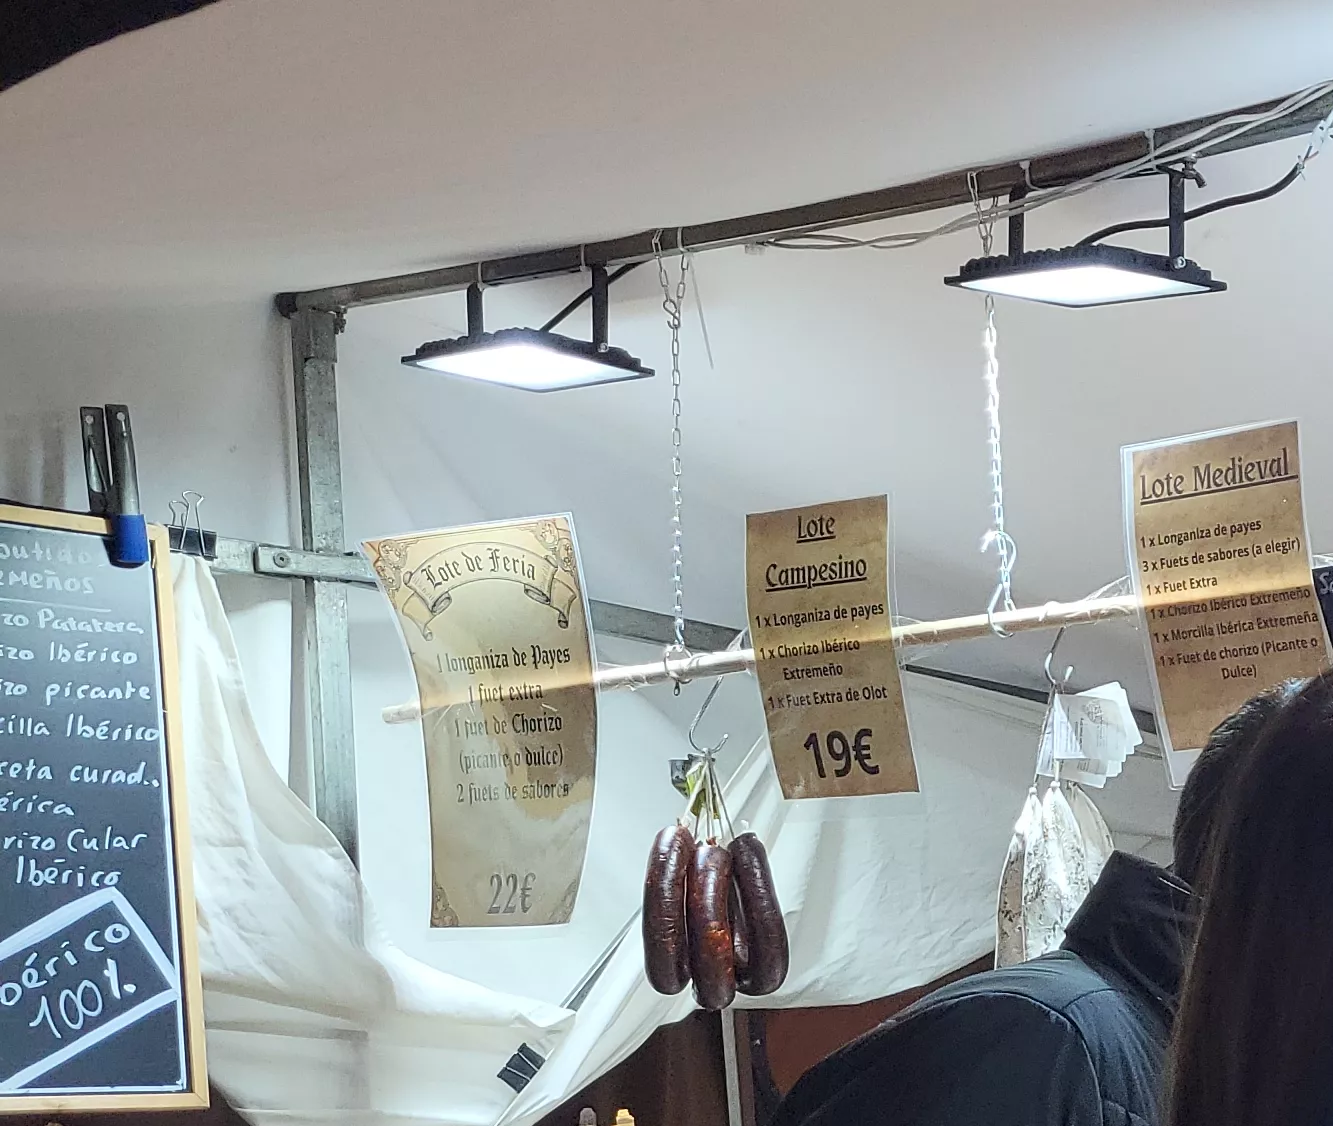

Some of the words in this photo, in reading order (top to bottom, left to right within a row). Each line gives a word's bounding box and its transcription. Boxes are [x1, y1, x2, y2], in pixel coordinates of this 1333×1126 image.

[1140, 472, 1185, 501] Lote
[1193, 447, 1289, 491] Medieval
[797, 515, 836, 541] Lote
[1140, 536, 1146, 548] 1
[1149, 538, 1155, 547] x
[1157, 527, 1211, 546] Longaniza
[1214, 523, 1227, 537] de
[1230, 520, 1262, 538] payes
[1142, 560, 1149, 572] 3
[1151, 561, 1158, 571] x
[1160, 556, 1189, 569] Fuets
[1191, 551, 1205, 564] de
[1207, 545, 1250, 562] sabores
[1251, 543, 1263, 558] (a
[1265, 536, 1301, 555] elegir)
[421, 560, 462, 589] Lote
[461, 552, 484, 573] de
[487, 548, 535, 581] Feria
[765, 555, 867, 590] Campesino
[1146, 583, 1152, 596] 1
[1154, 584, 1162, 594] x
[1163, 580, 1187, 593] Fuet
[1190, 575, 1218, 589] Extra
[755, 615, 762, 629] 1
[764, 617, 772, 627] x
[773, 610, 831, 629] Longaniza
[833, 605, 848, 620] de
[851, 602, 884, 621] payes
[1150, 607, 1156, 619] 1
[1159, 608, 1165, 618] x
[1167, 602, 1208, 618] Chorizo
[1210, 597, 1247, 612] Ibérico
[1250, 587, 1311, 606] Extremeño
[1153, 632, 1160, 644] 1
[1162, 632, 1169, 642] x
[1171, 624, 1215, 642] Morcilla
[1217, 620, 1254, 638] Ibérica
[1256, 611, 1319, 630] Extremeña
[50, 641, 138, 665] Ibérico
[446, 650, 509, 675] longaniza
[512, 646, 527, 667] de
[531, 645, 571, 670] Payes
[760, 647, 766, 661] 1
[768, 650, 775, 660] x
[777, 642, 819, 658] Chorizo
[821, 638, 860, 653] Ibérico
[1159, 655, 1165, 667] 1
[1168, 656, 1175, 666] x
[1177, 652, 1201, 666] Fuet
[1203, 648, 1217, 662] de
[1219, 643, 1259, 661] chorizo
[1261, 639, 1308, 656] (Picante
[1310, 637, 1318, 647] o
[783, 663, 843, 681] Extremeño
[1221, 664, 1257, 680] Dulce)
[45, 681, 151, 705] picante
[468, 687, 474, 704] 1
[477, 684, 505, 706] fuet
[509, 684, 543, 700] extra
[768, 696, 775, 709] 1
[778, 698, 785, 708] x
[786, 692, 811, 707] Fuet
[813, 688, 843, 706] Extra
[845, 686, 860, 701] de
[862, 686, 888, 700] Olot
[455, 720, 460, 737] 1
[464, 719, 488, 739] fuet
[493, 716, 507, 735] de
[512, 712, 562, 735] Chorizo
[459, 749, 509, 774] (picante
[514, 754, 520, 766] o
[525, 744, 564, 766] dulce)
[804, 728, 880, 778] 19€
[456, 784, 465, 803] 2
[468, 782, 499, 806] fuets
[504, 781, 518, 799] de
[522, 779, 570, 799] sabores
[67, 826, 147, 852] Cular
[16, 855, 121, 887] Ibérico
[487, 872, 536, 915] 22€
